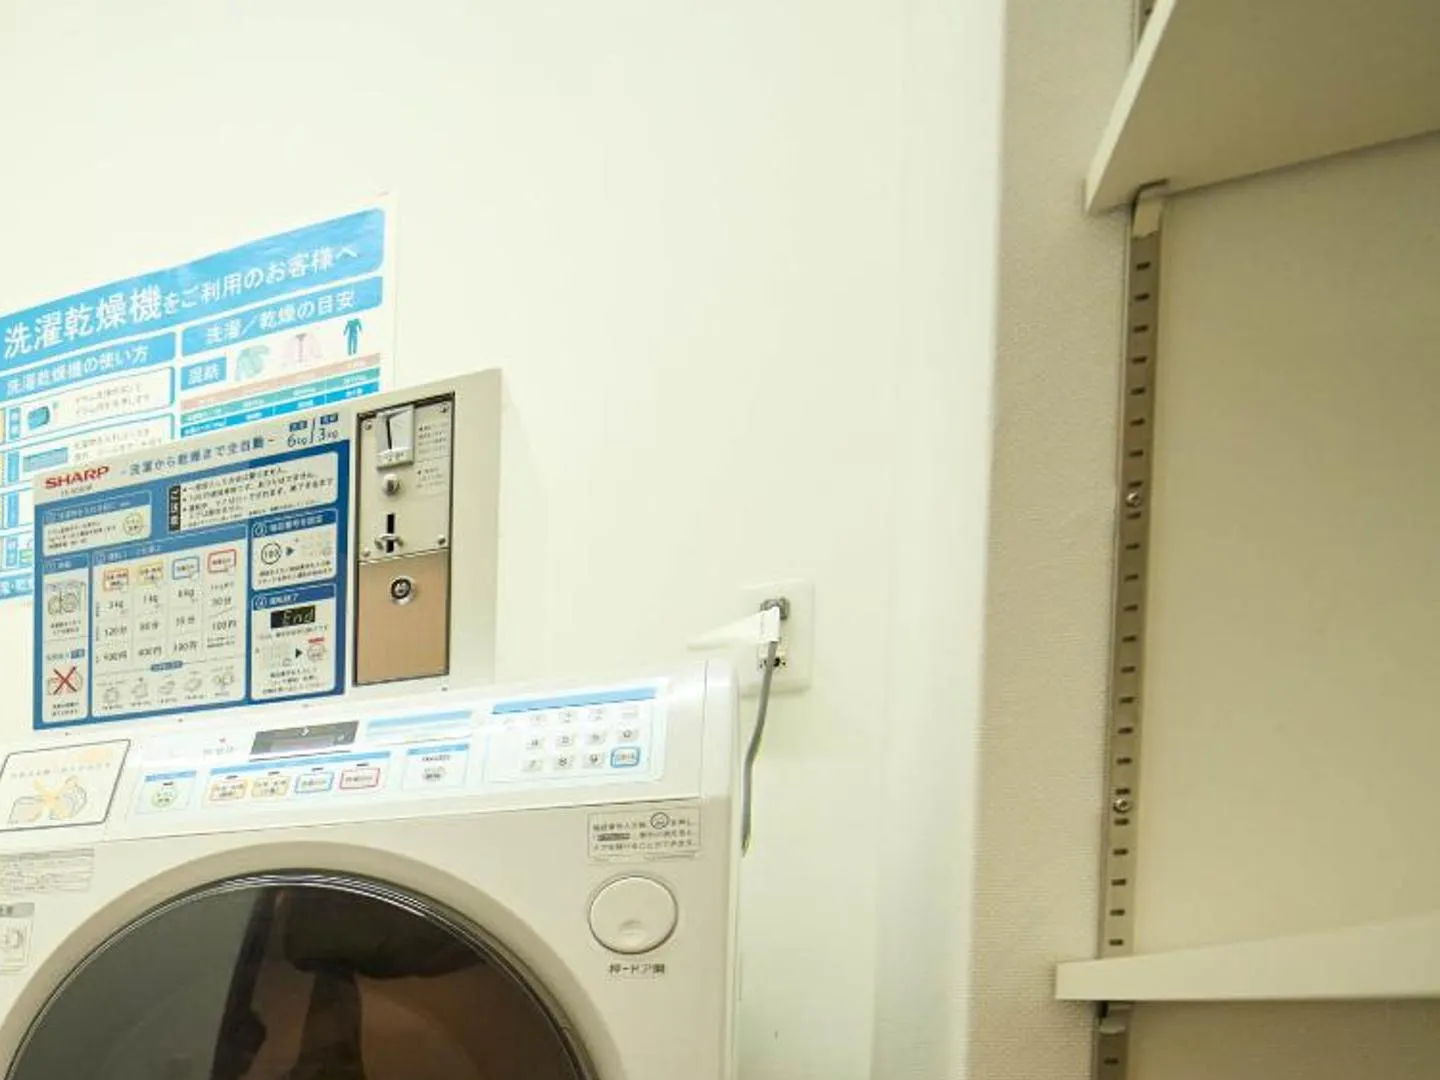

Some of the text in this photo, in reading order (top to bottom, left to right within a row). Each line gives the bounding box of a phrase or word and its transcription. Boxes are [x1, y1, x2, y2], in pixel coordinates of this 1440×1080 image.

[3, 246, 358, 359] 洗濯乾燥機をご利用のお客様へ
[45, 465, 110, 489] SHARP
